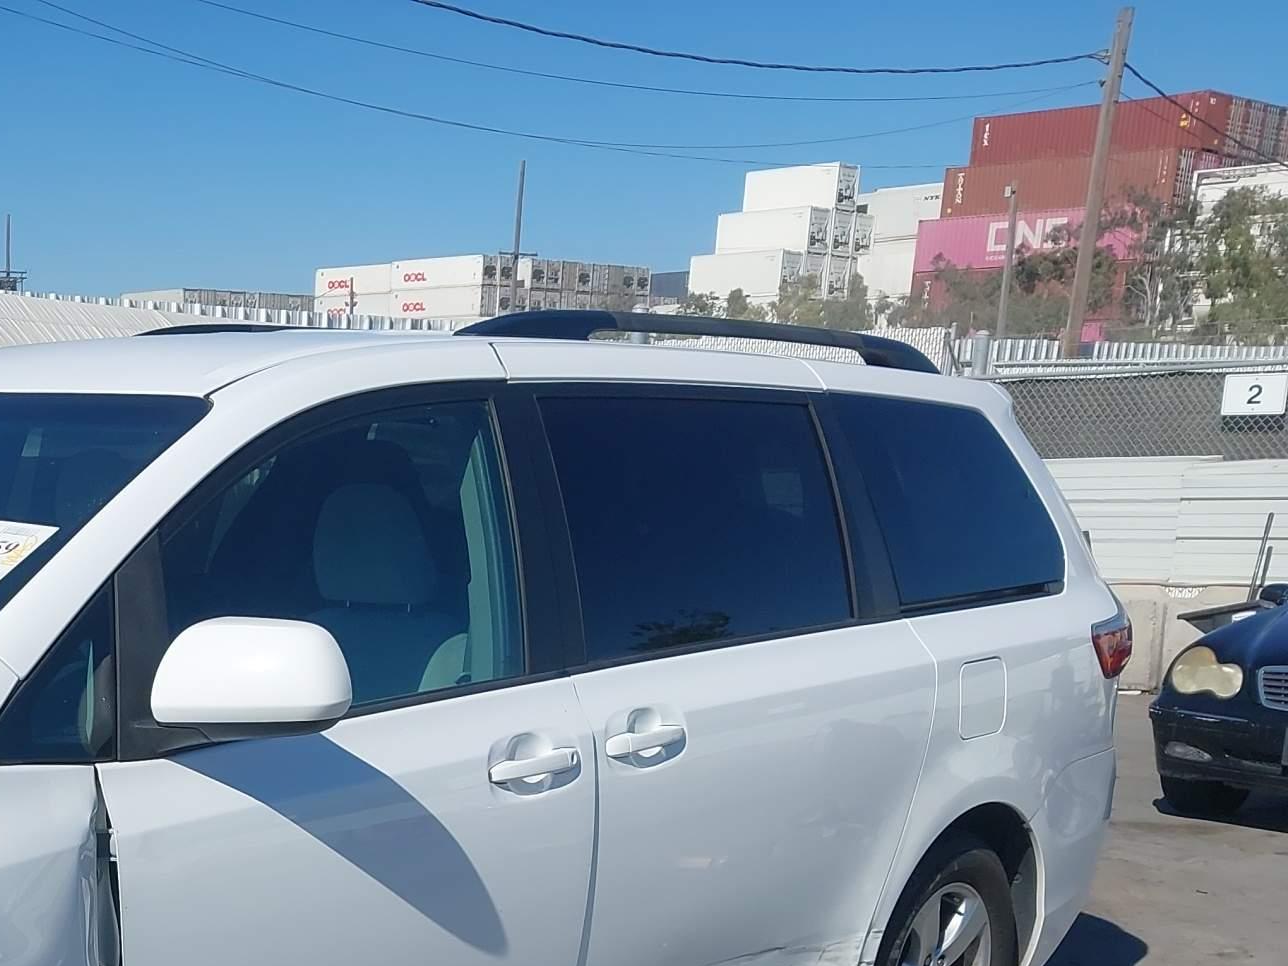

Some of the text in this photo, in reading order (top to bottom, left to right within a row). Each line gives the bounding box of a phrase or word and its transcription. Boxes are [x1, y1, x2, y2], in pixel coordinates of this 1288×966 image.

[403, 272, 427, 282] OOCL
[328, 280, 350, 290] OOCL
[402, 302, 426, 312] OOCL
[1246, 384, 1263, 405] 2
